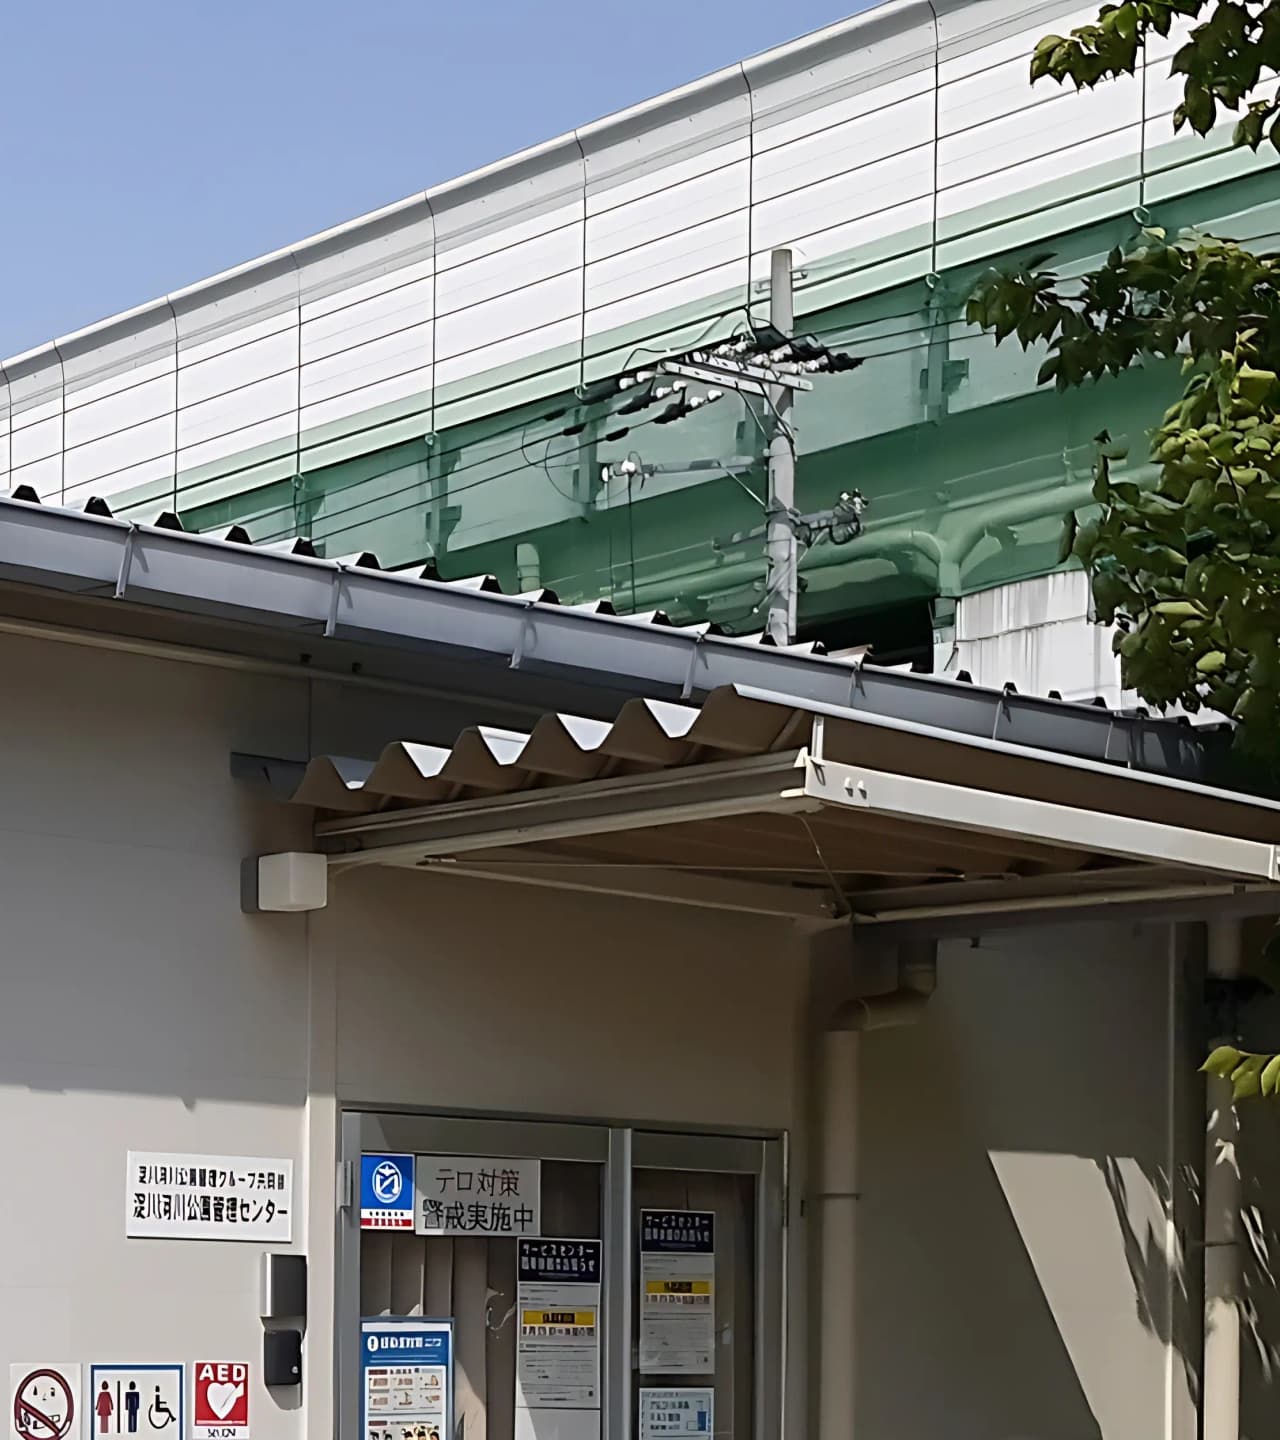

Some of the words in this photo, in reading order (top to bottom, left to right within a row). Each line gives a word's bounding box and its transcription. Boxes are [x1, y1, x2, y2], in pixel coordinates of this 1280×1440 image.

[435, 1168, 520, 1197] テロ対策
[133, 1192, 288, 1223] 淀川河川公園管理センター
[422, 1198, 534, 1232] 警戒実施中
[199, 1364, 246, 1382] AED
